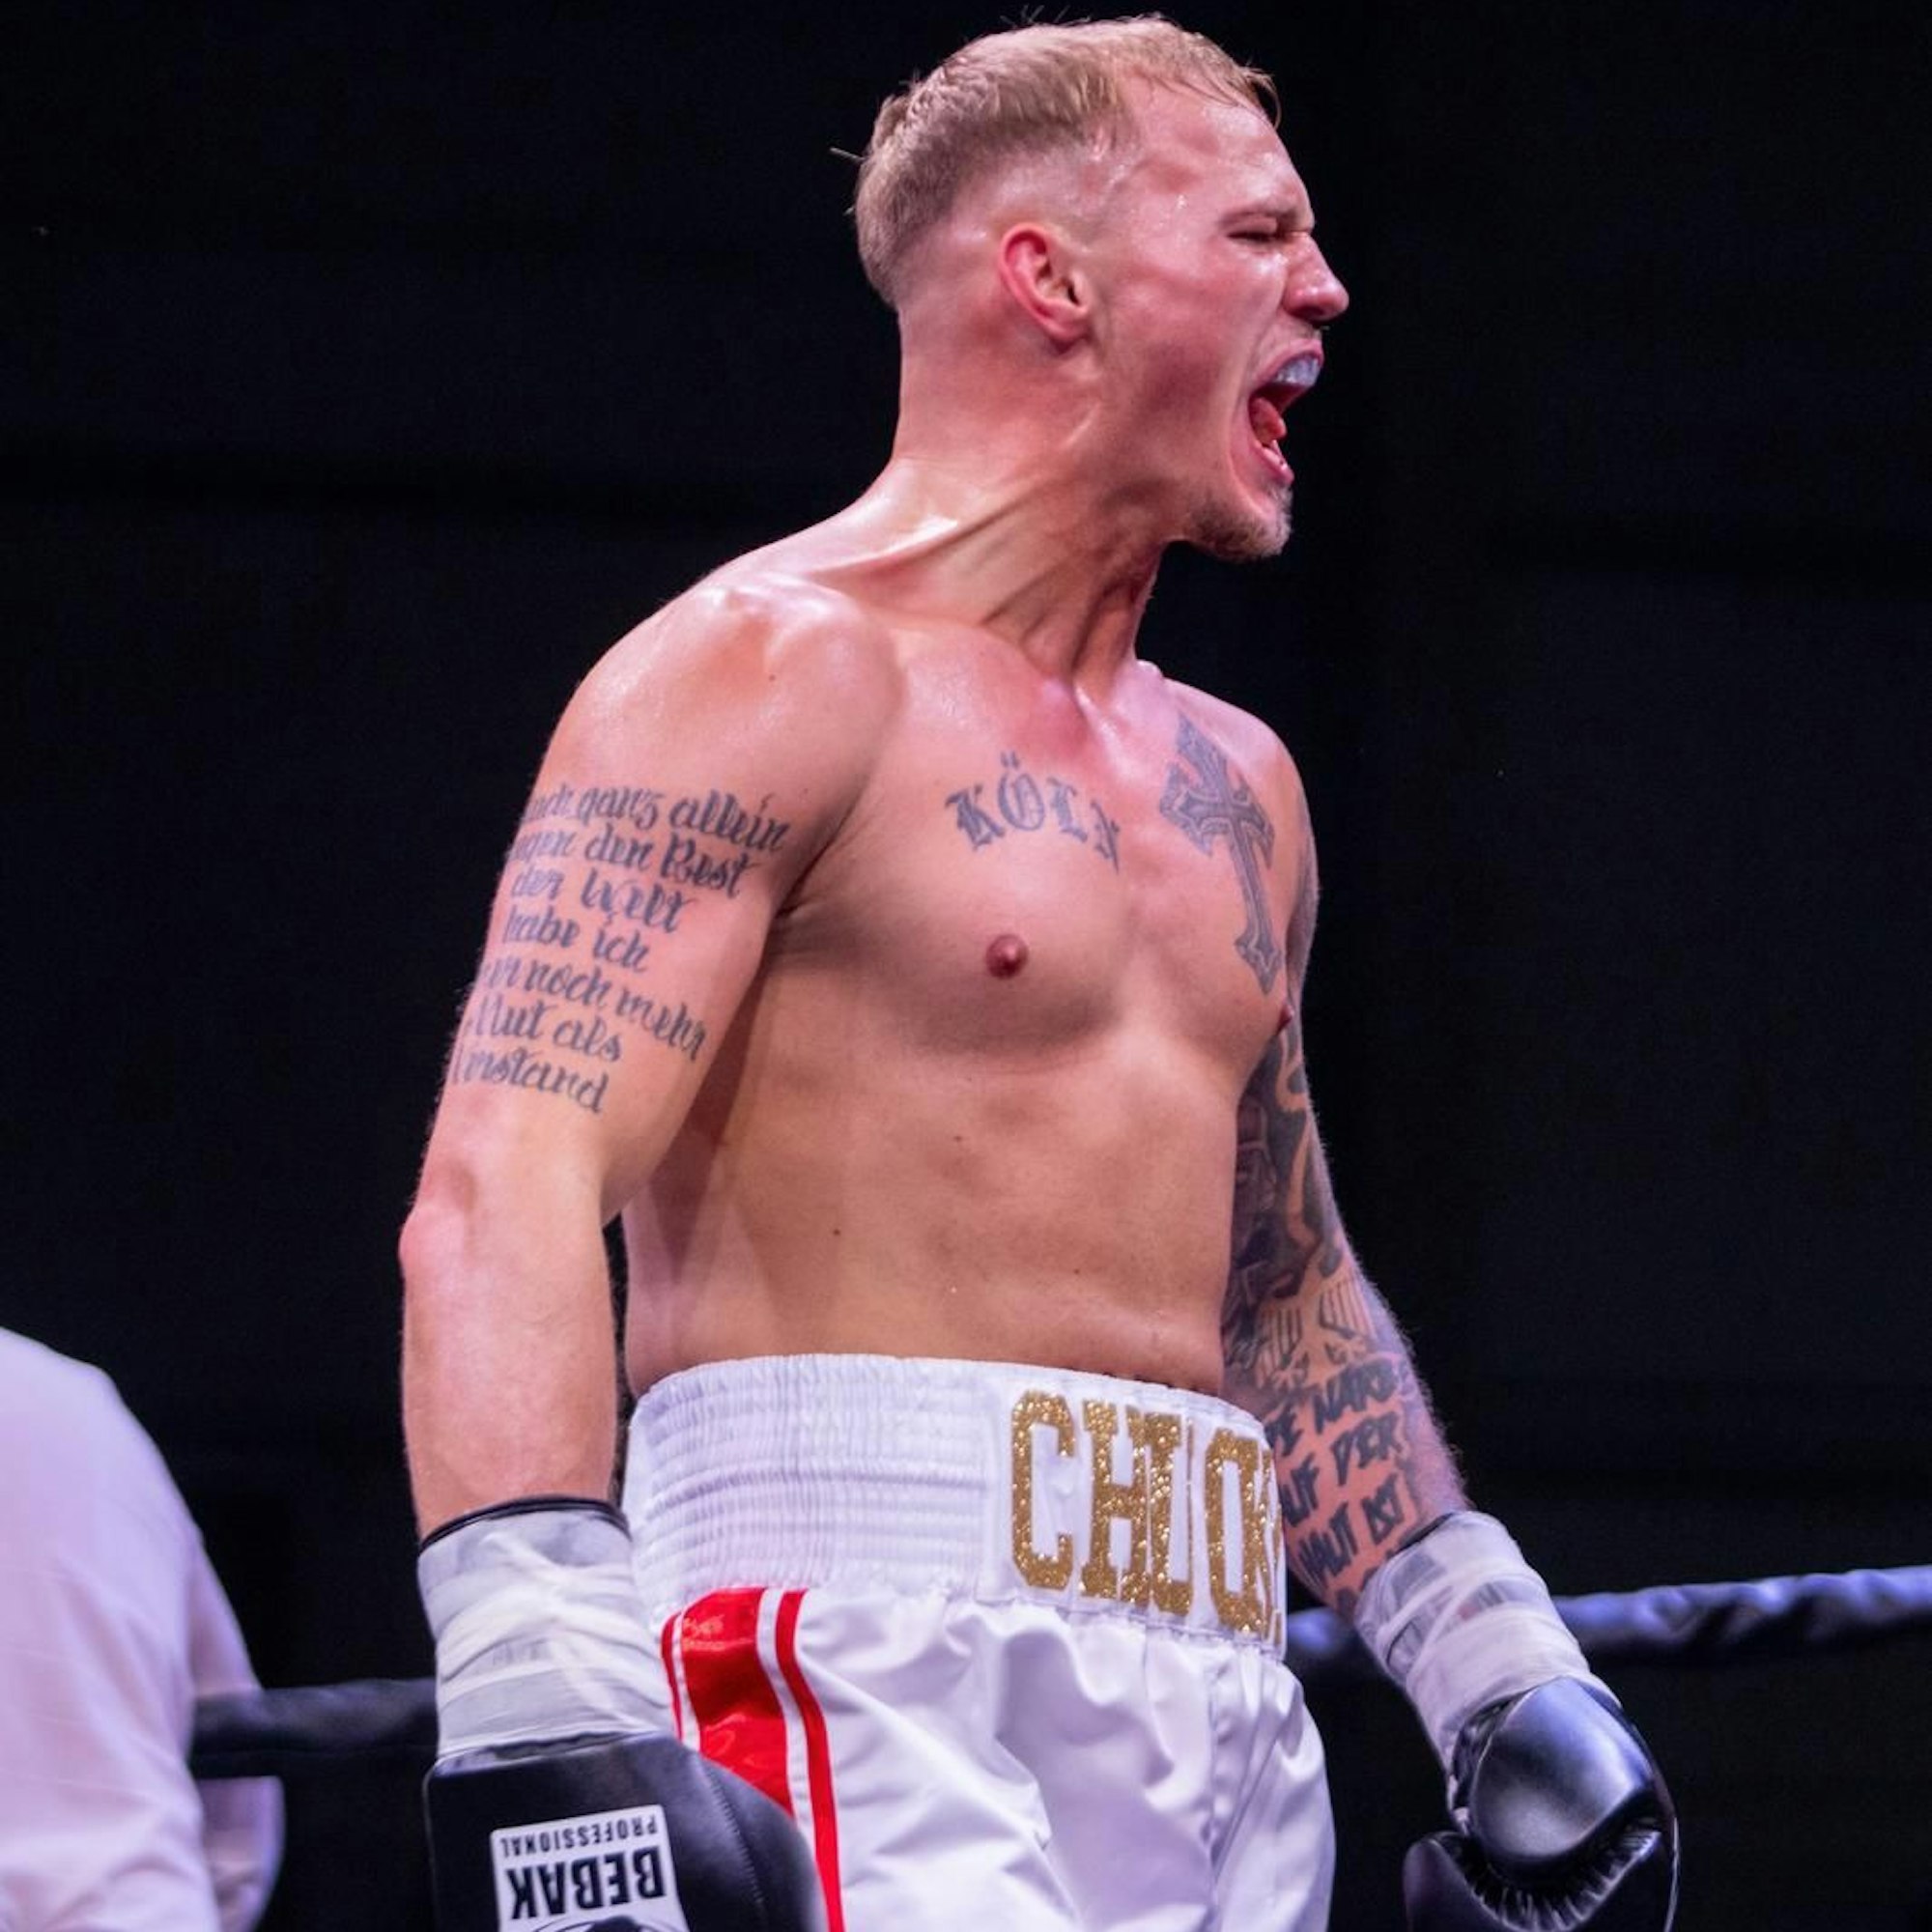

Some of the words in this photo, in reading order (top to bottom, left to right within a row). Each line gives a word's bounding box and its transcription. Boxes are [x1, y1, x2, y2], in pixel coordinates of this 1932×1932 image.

[577, 787, 665, 830] ganz
[668, 789, 790, 852] allein
[584, 822, 655, 870] den
[661, 832, 764, 898] Rest
[592, 910, 649, 973] ich
[525, 960, 612, 1009] noch
[615, 986, 705, 1062] mehr
[554, 1015, 620, 1062] als
[500, 1815, 659, 1858] PROFESSIONAL
[506, 1846, 667, 1919] BEBAK
